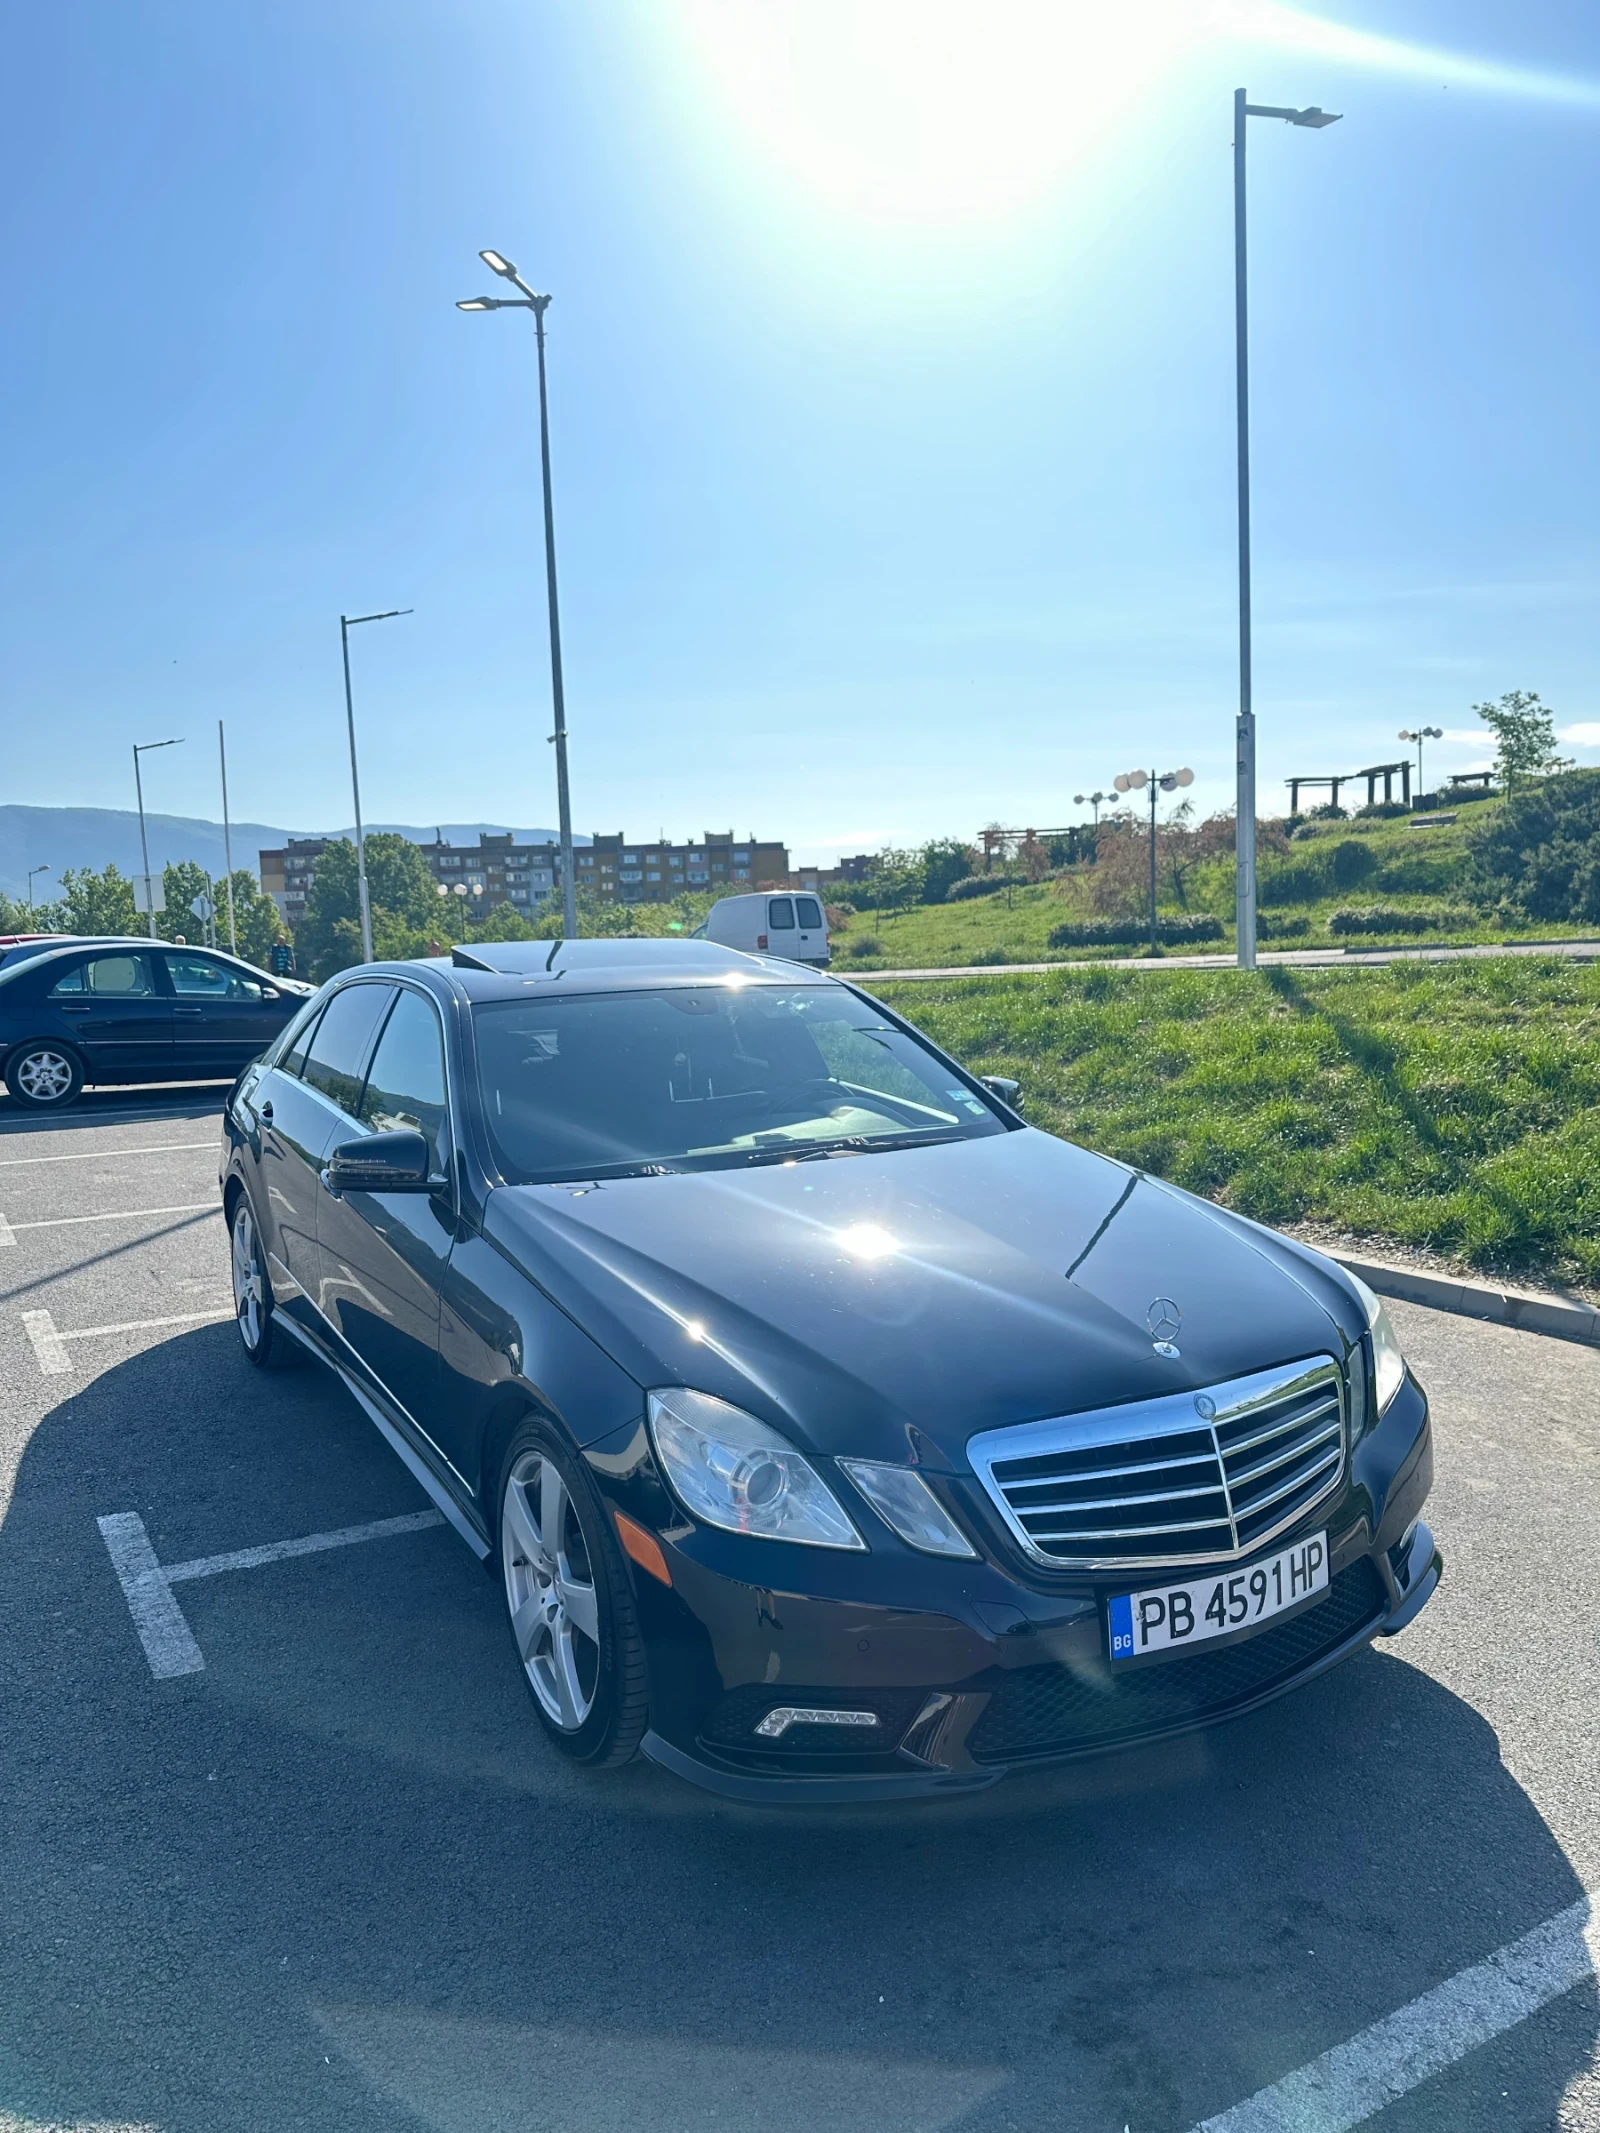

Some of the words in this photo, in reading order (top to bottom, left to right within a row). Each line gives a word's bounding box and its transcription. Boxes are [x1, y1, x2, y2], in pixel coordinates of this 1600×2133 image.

[1139, 1590, 1195, 1646] PB
[1205, 1560, 1283, 1628] 4591
[1290, 1541, 1323, 1598] HP
[1113, 1634, 1132, 1651] BG
